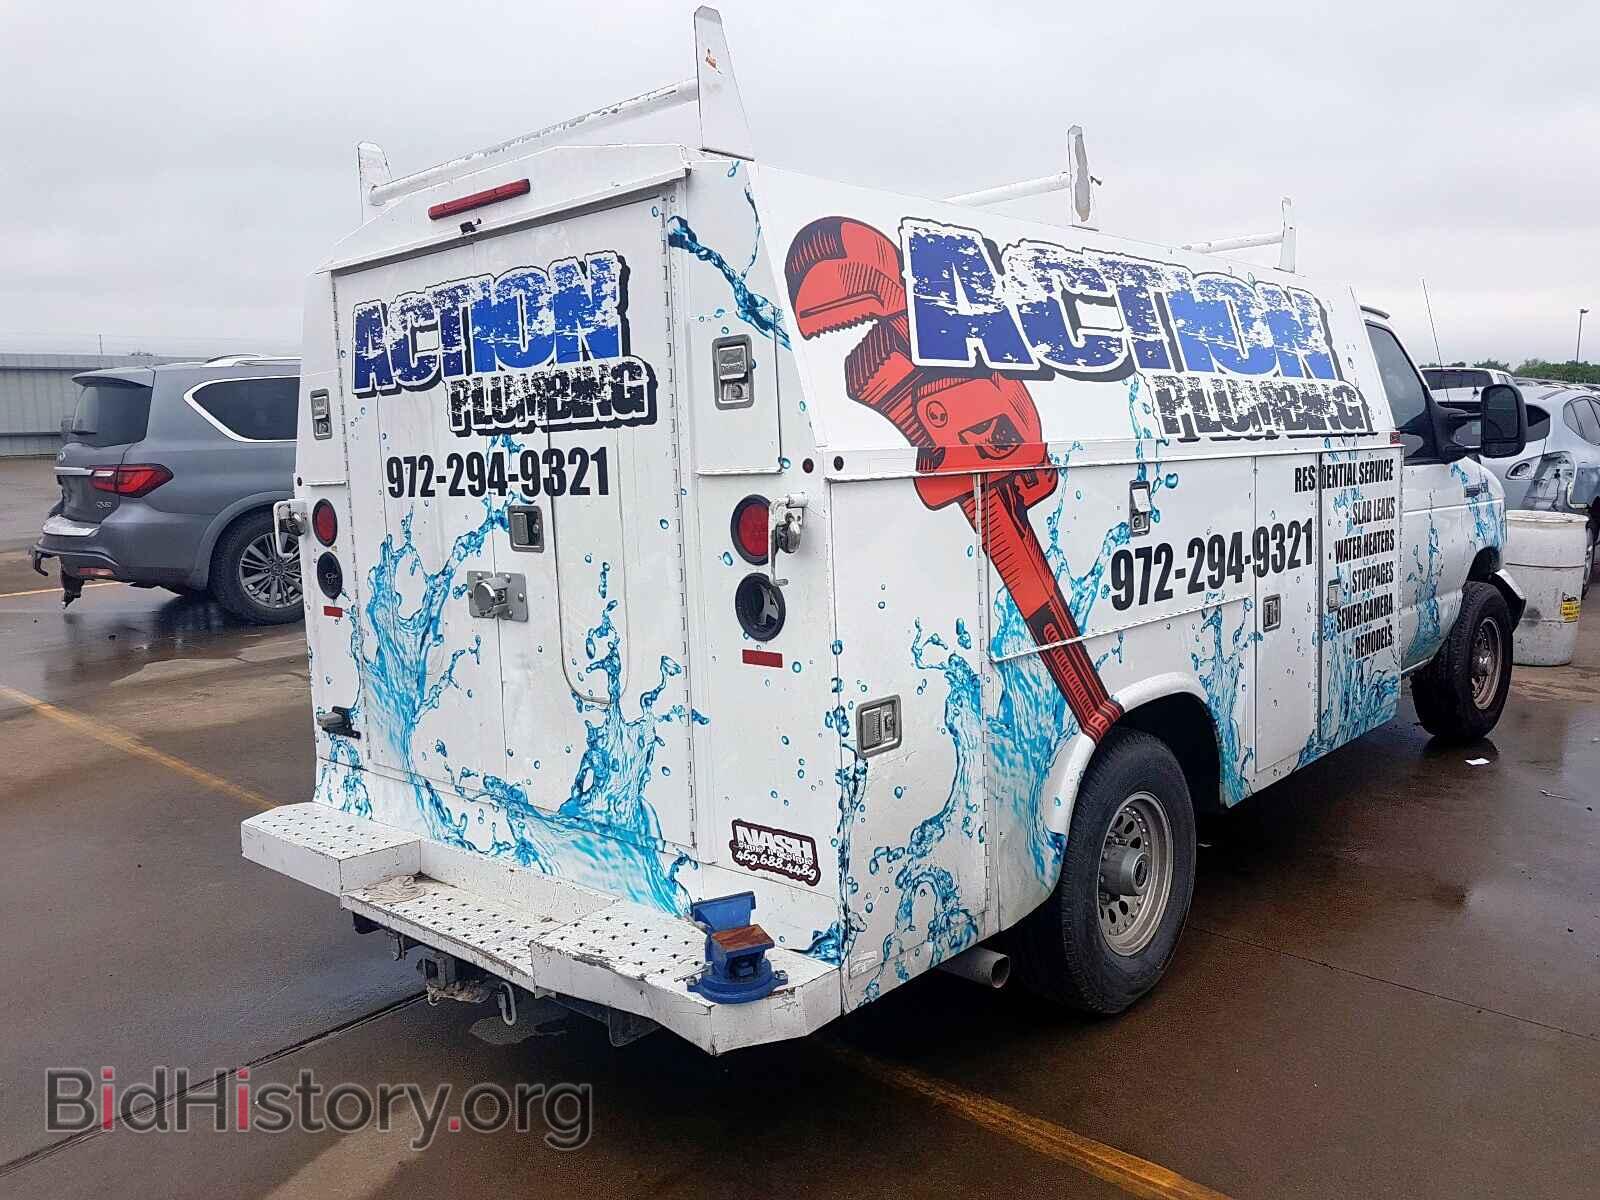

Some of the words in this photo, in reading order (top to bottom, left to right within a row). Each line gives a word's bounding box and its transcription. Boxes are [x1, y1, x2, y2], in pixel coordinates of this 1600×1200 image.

[902, 221, 1342, 383] ACTION
[353, 252, 624, 393] ACTION
[387, 447, 609, 498] 972-294-9321
[1295, 463, 1357, 493] RESDENTIAL
[1359, 459, 1393, 485] SERVICE
[1353, 500, 1372, 526] SLAB
[1374, 497, 1395, 521] LEAKS
[1111, 517, 1313, 611] 972-294-9321
[1335, 536, 1361, 564] WATER
[1364, 529, 1395, 557] HEATERS
[1352, 561, 1394, 594] STOPPAGES
[1336, 602, 1362, 634] SEWER
[1363, 593, 1393, 623] CAMERA
[1355, 625, 1392, 660] REMODELS
[735, 825, 814, 858] NASH
